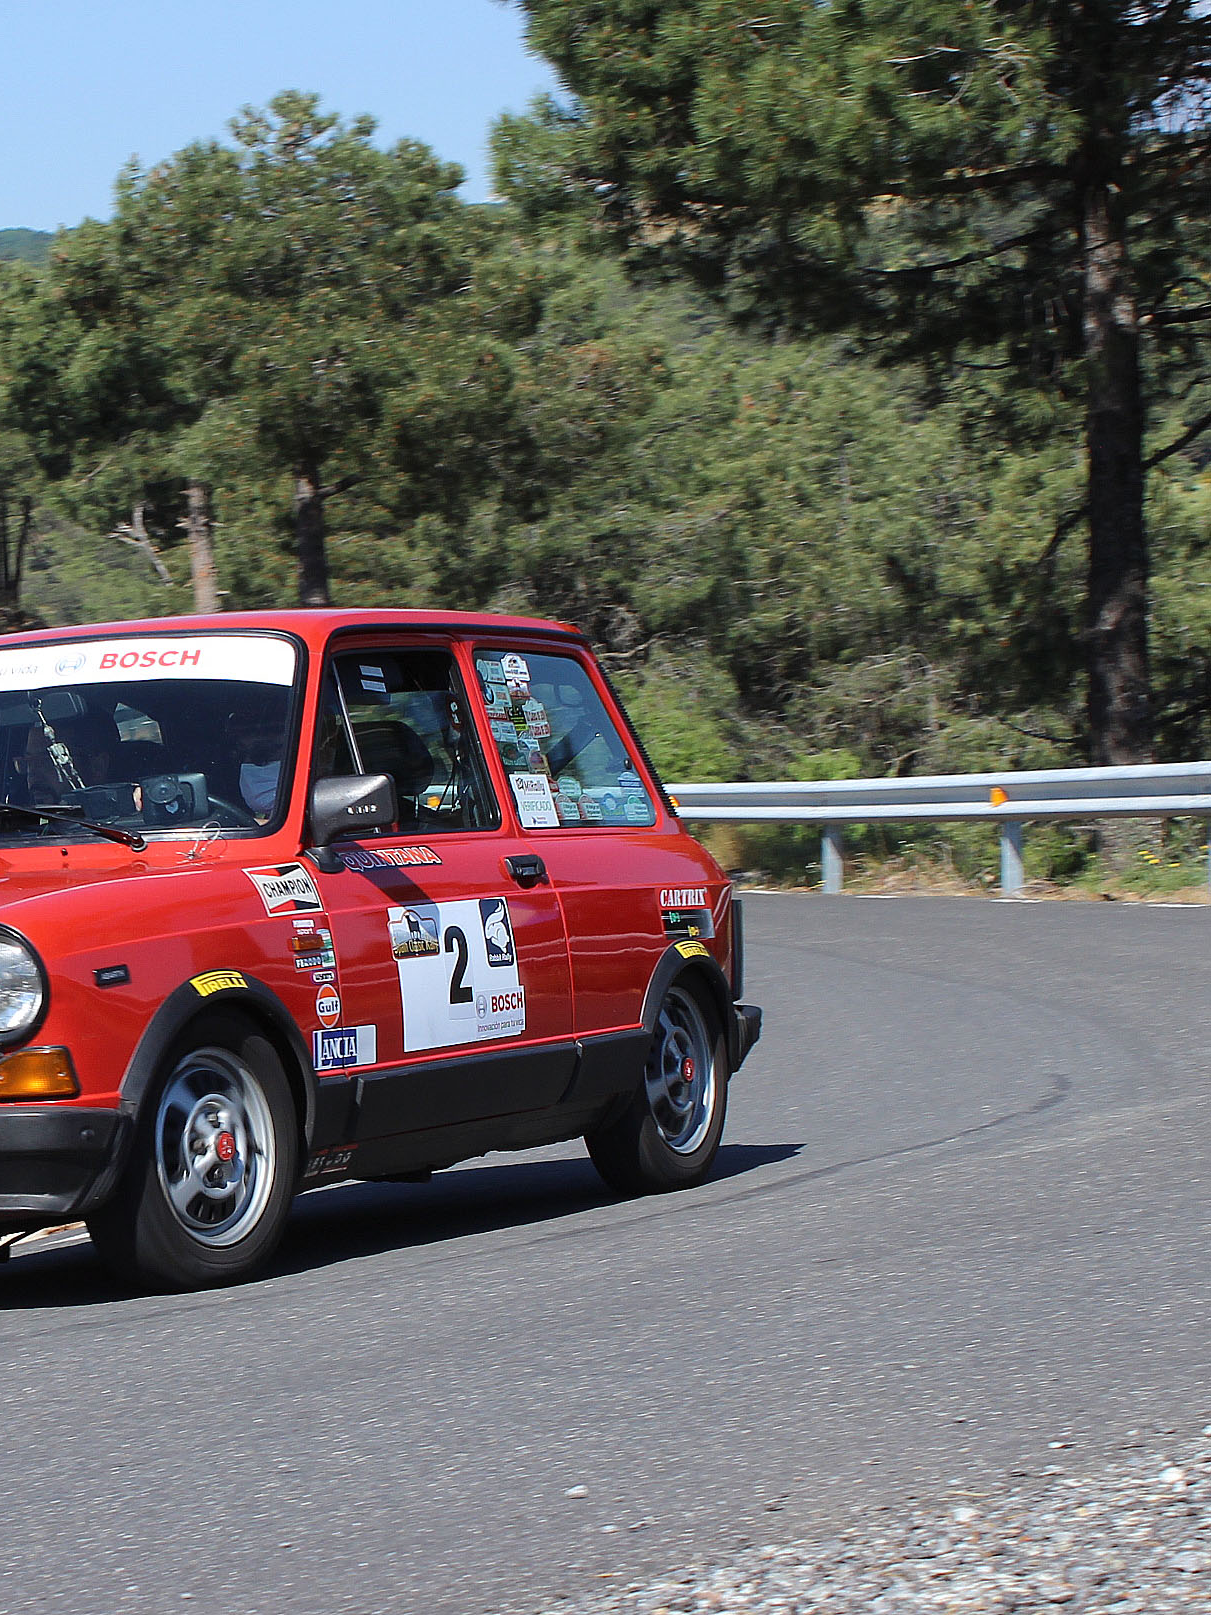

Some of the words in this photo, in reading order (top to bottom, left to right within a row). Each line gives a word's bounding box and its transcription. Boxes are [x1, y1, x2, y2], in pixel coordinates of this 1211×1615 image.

[99, 650, 201, 670] BOSCH
[342, 847, 442, 873] QUINTANA
[262, 878, 313, 899] CHAMPION
[660, 888, 706, 907] CARTRIX
[444, 925, 473, 1005] 2
[189, 970, 248, 997] PIRELLI
[318, 999, 339, 1013] Gulf
[491, 991, 524, 1013] BOSCH
